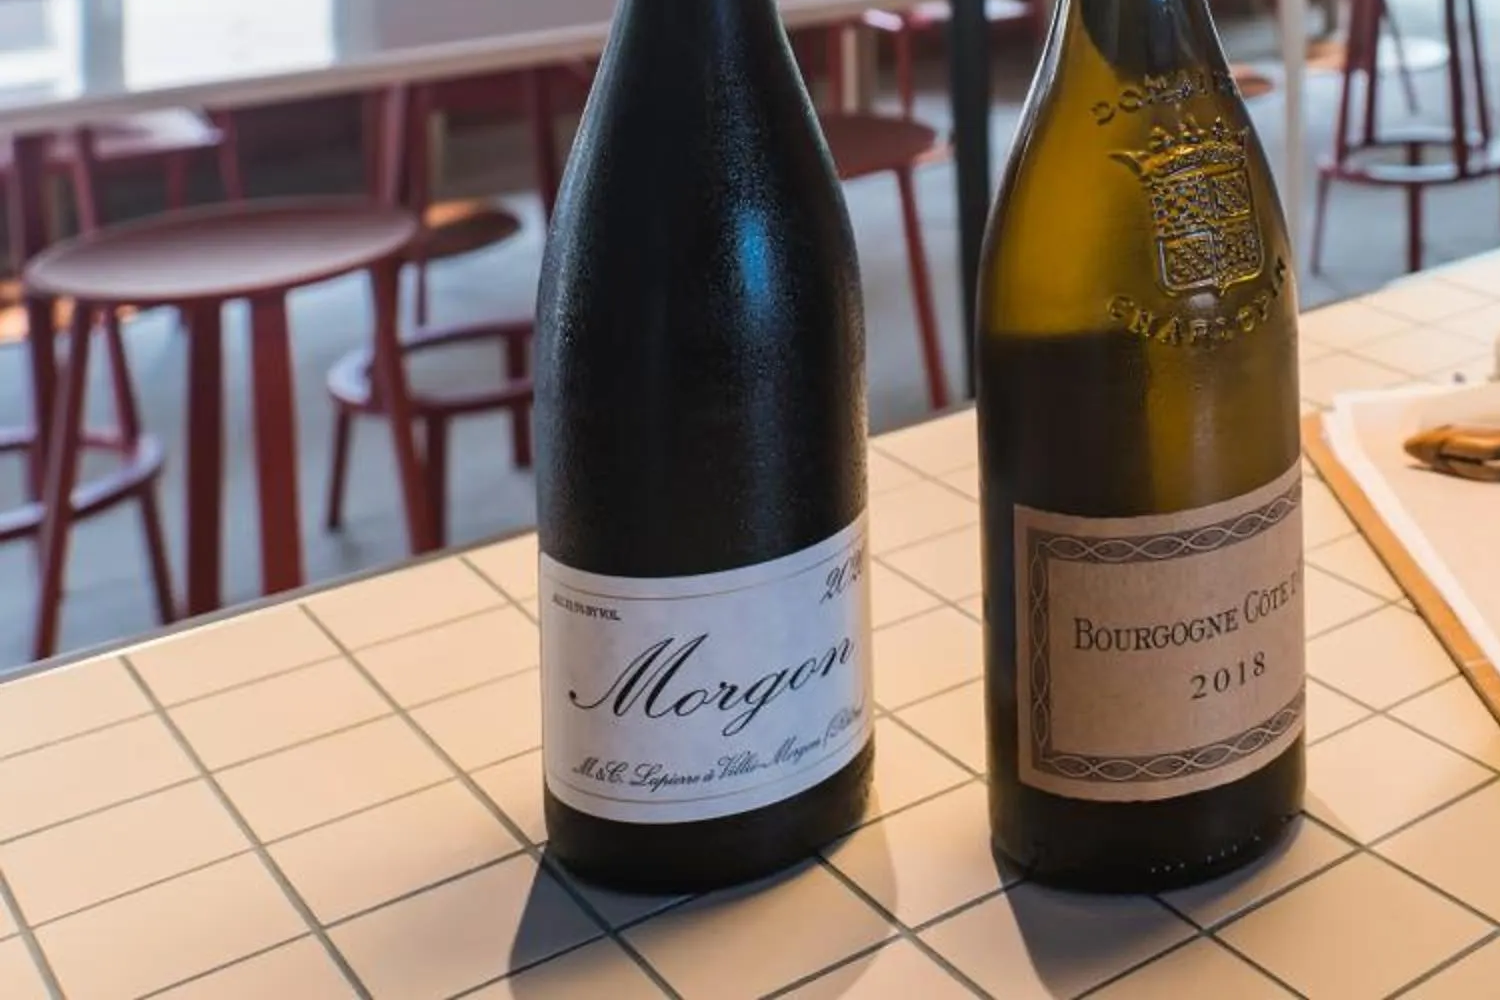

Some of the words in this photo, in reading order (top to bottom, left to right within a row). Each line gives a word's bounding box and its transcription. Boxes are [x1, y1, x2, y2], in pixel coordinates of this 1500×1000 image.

[1074, 606, 1239, 652] BOURGOGNE
[1244, 582, 1289, 624] CÔTE
[569, 632, 855, 737] Morgon
[1190, 651, 1266, 700] 2018
